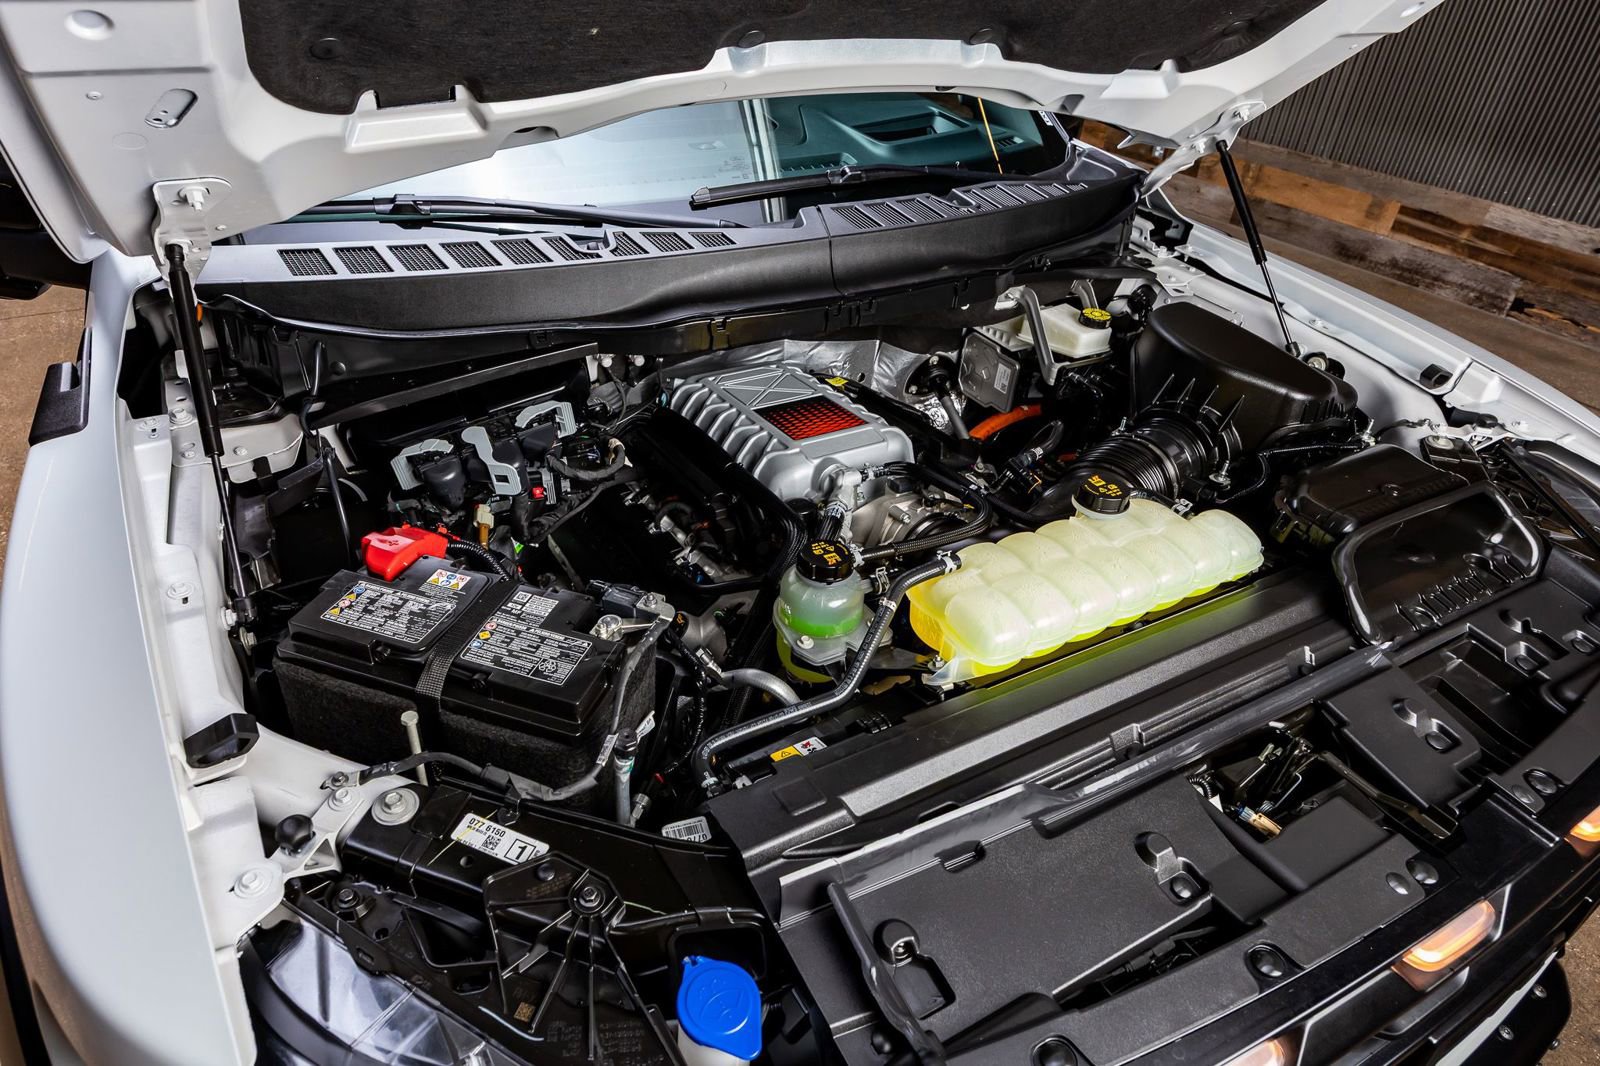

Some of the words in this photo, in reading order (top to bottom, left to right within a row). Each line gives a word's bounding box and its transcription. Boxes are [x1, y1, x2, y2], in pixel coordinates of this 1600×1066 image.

[469, 818, 485, 828] 077
[485, 825, 506, 837] 6150
[515, 845, 528, 860] 1
